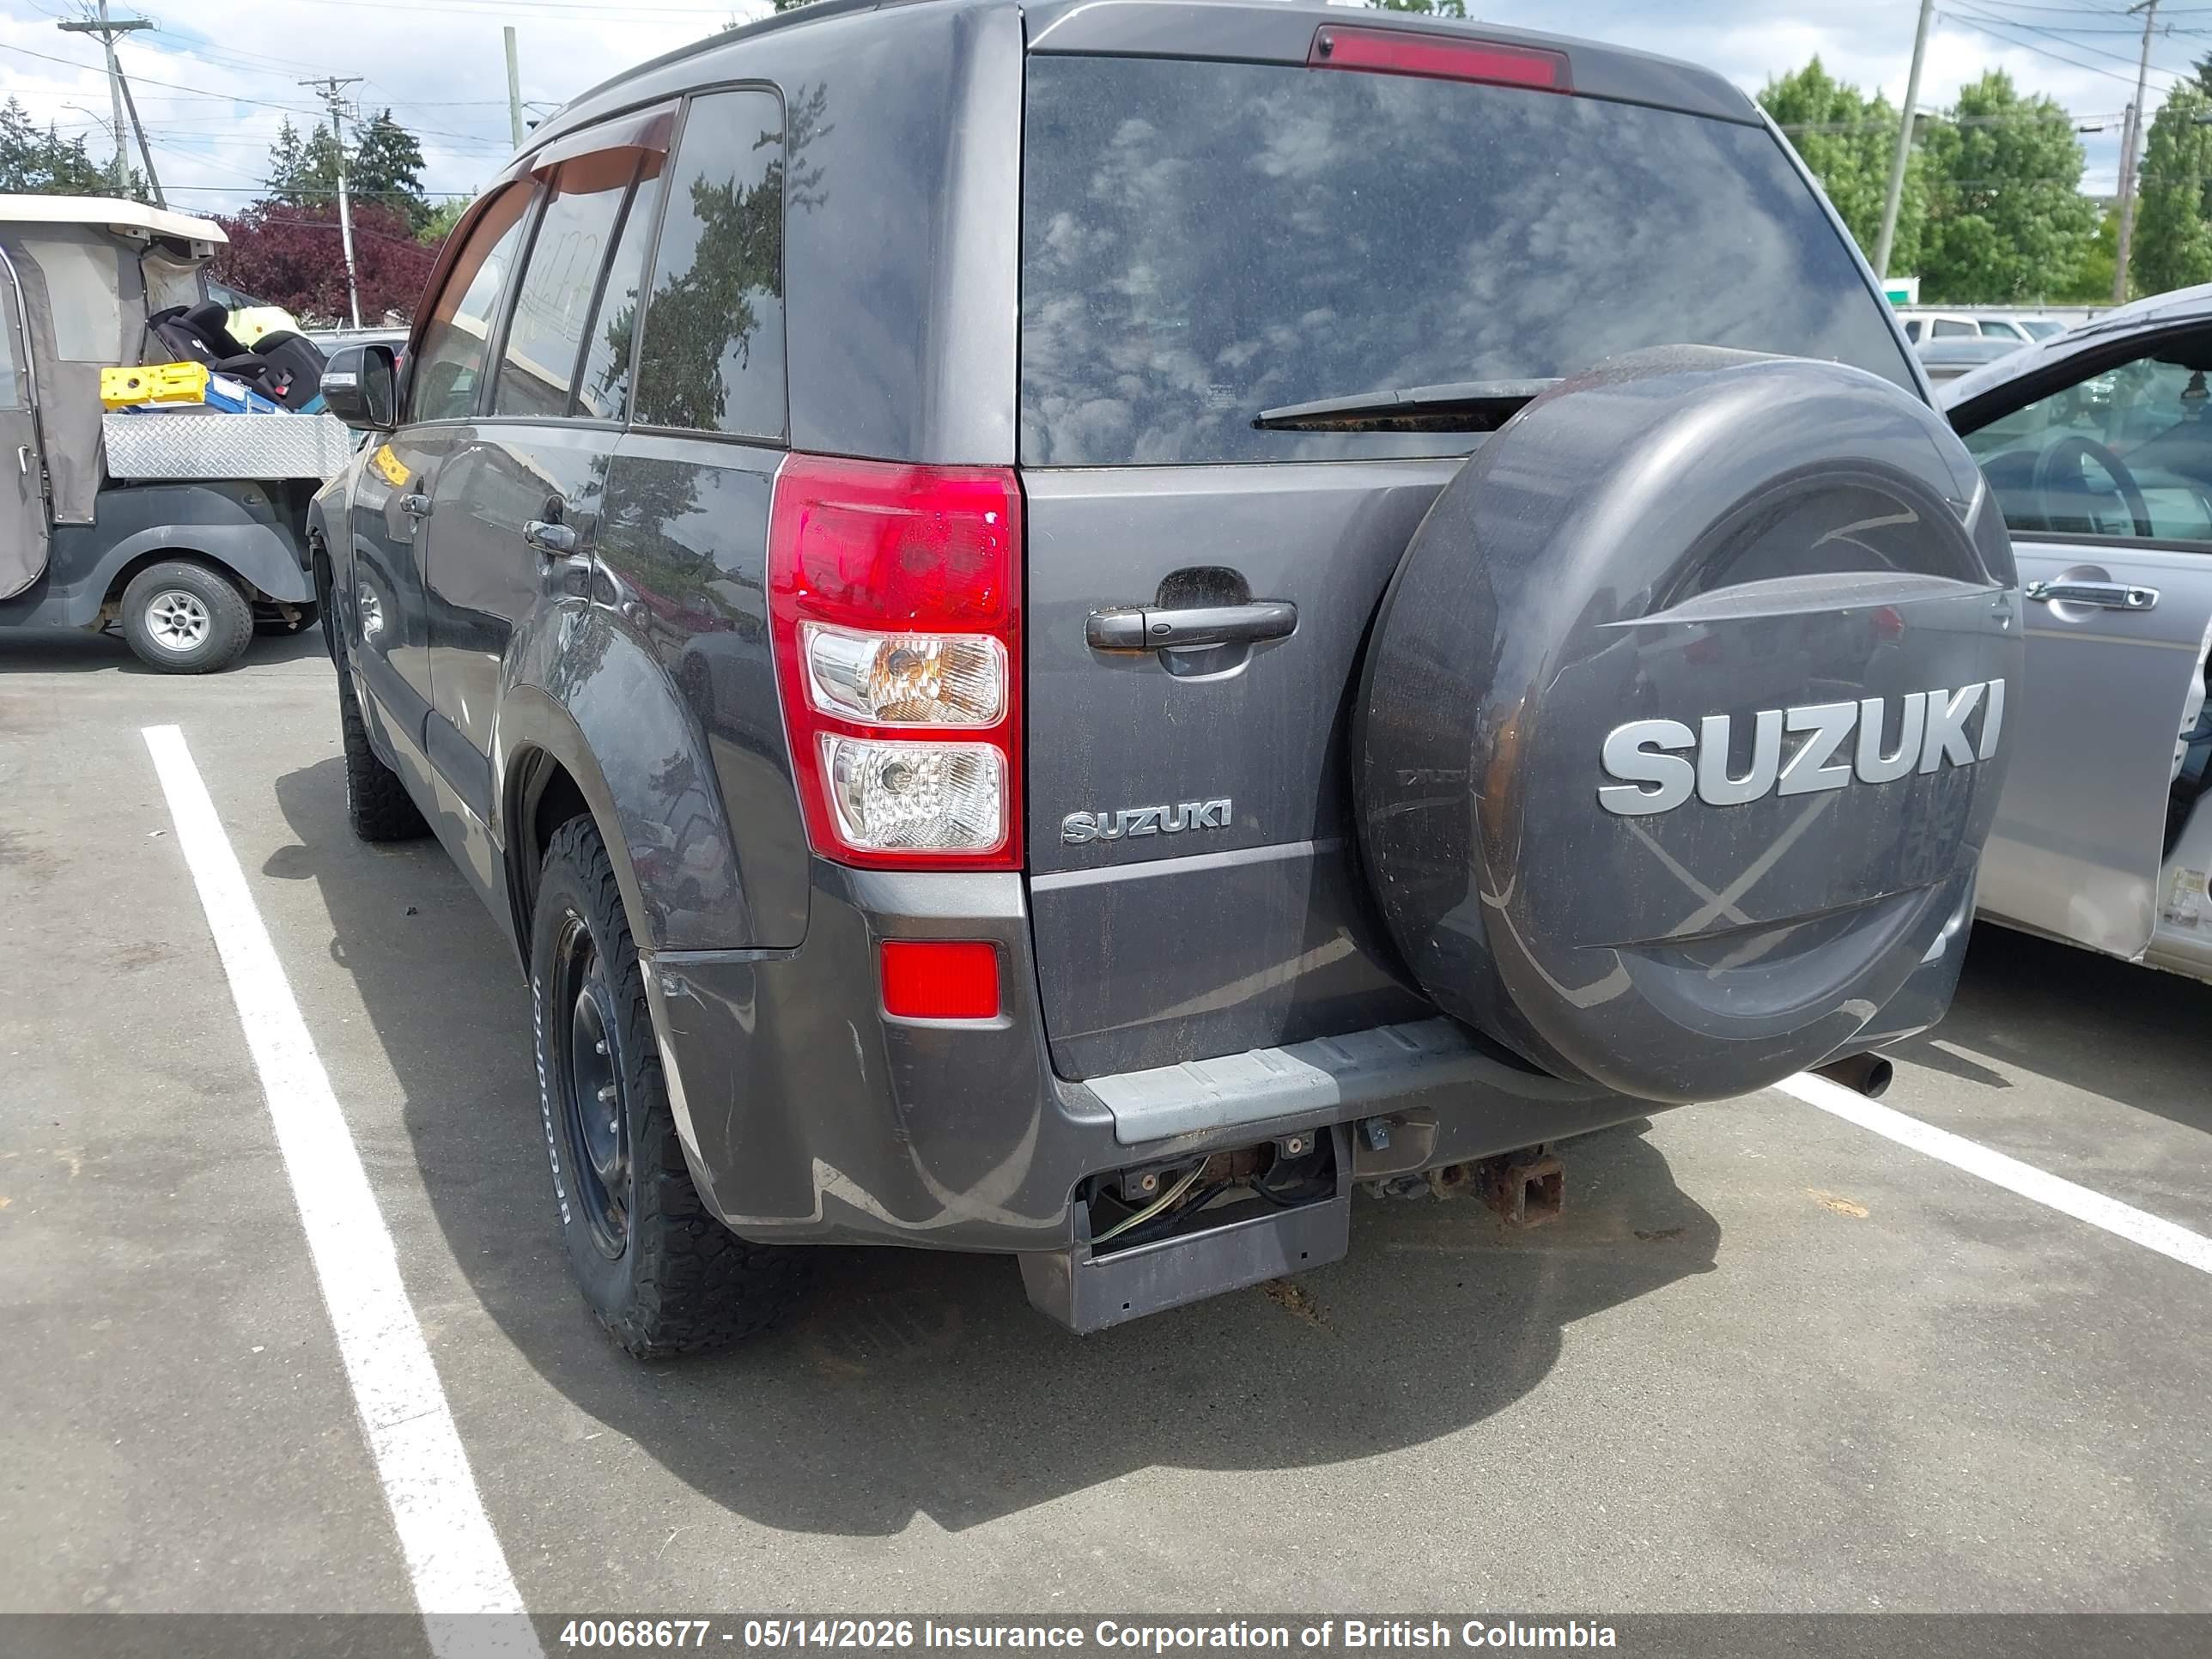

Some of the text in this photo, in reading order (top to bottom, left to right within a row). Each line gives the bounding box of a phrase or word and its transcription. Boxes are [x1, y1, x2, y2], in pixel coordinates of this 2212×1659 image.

[1597, 678, 2005, 815] SUZUKI
[1061, 799, 1231, 843] SUZUKI
[532, 975, 571, 1224] BFGoodrich
